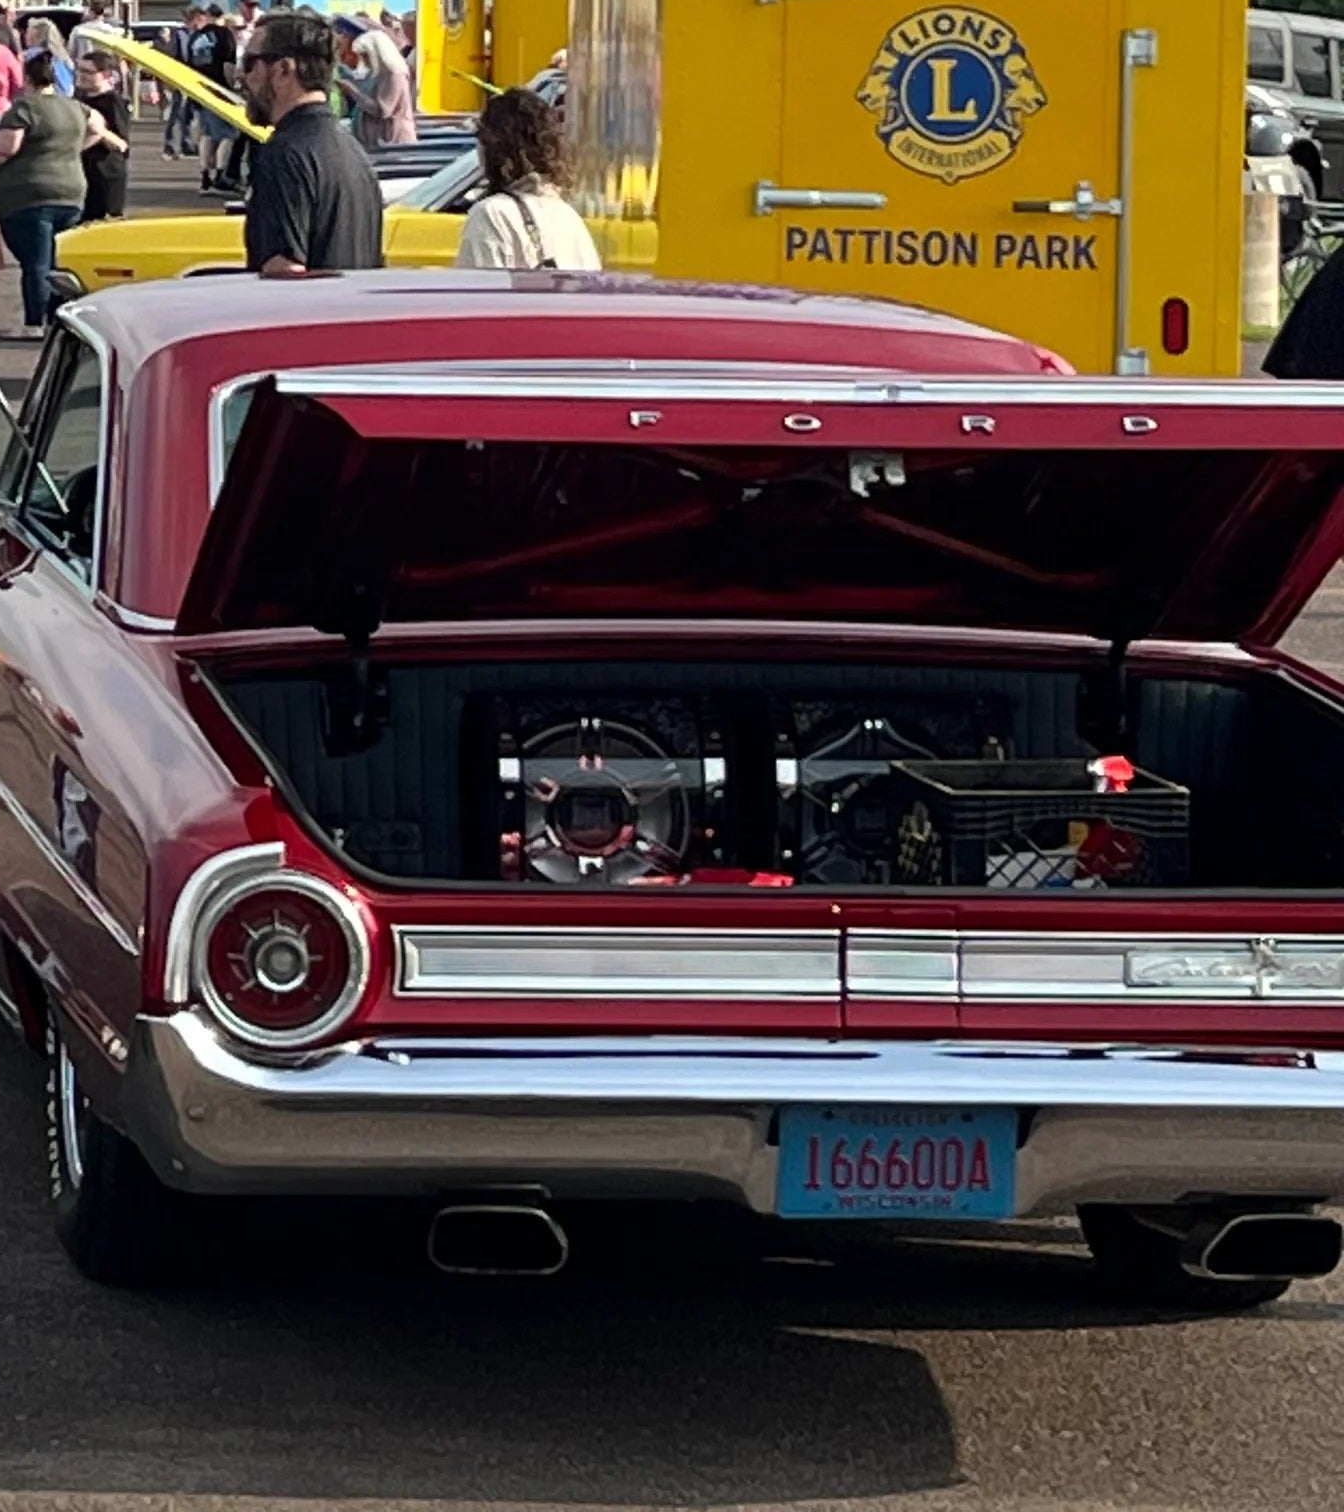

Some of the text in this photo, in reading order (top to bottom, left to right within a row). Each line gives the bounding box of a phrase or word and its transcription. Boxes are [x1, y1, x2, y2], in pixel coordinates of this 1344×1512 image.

[898, 12, 1006, 50] LIONS
[926, 58, 978, 121] L
[785, 226, 1099, 270] PATTISON PARK
[803, 1134, 991, 1192] 166600A
